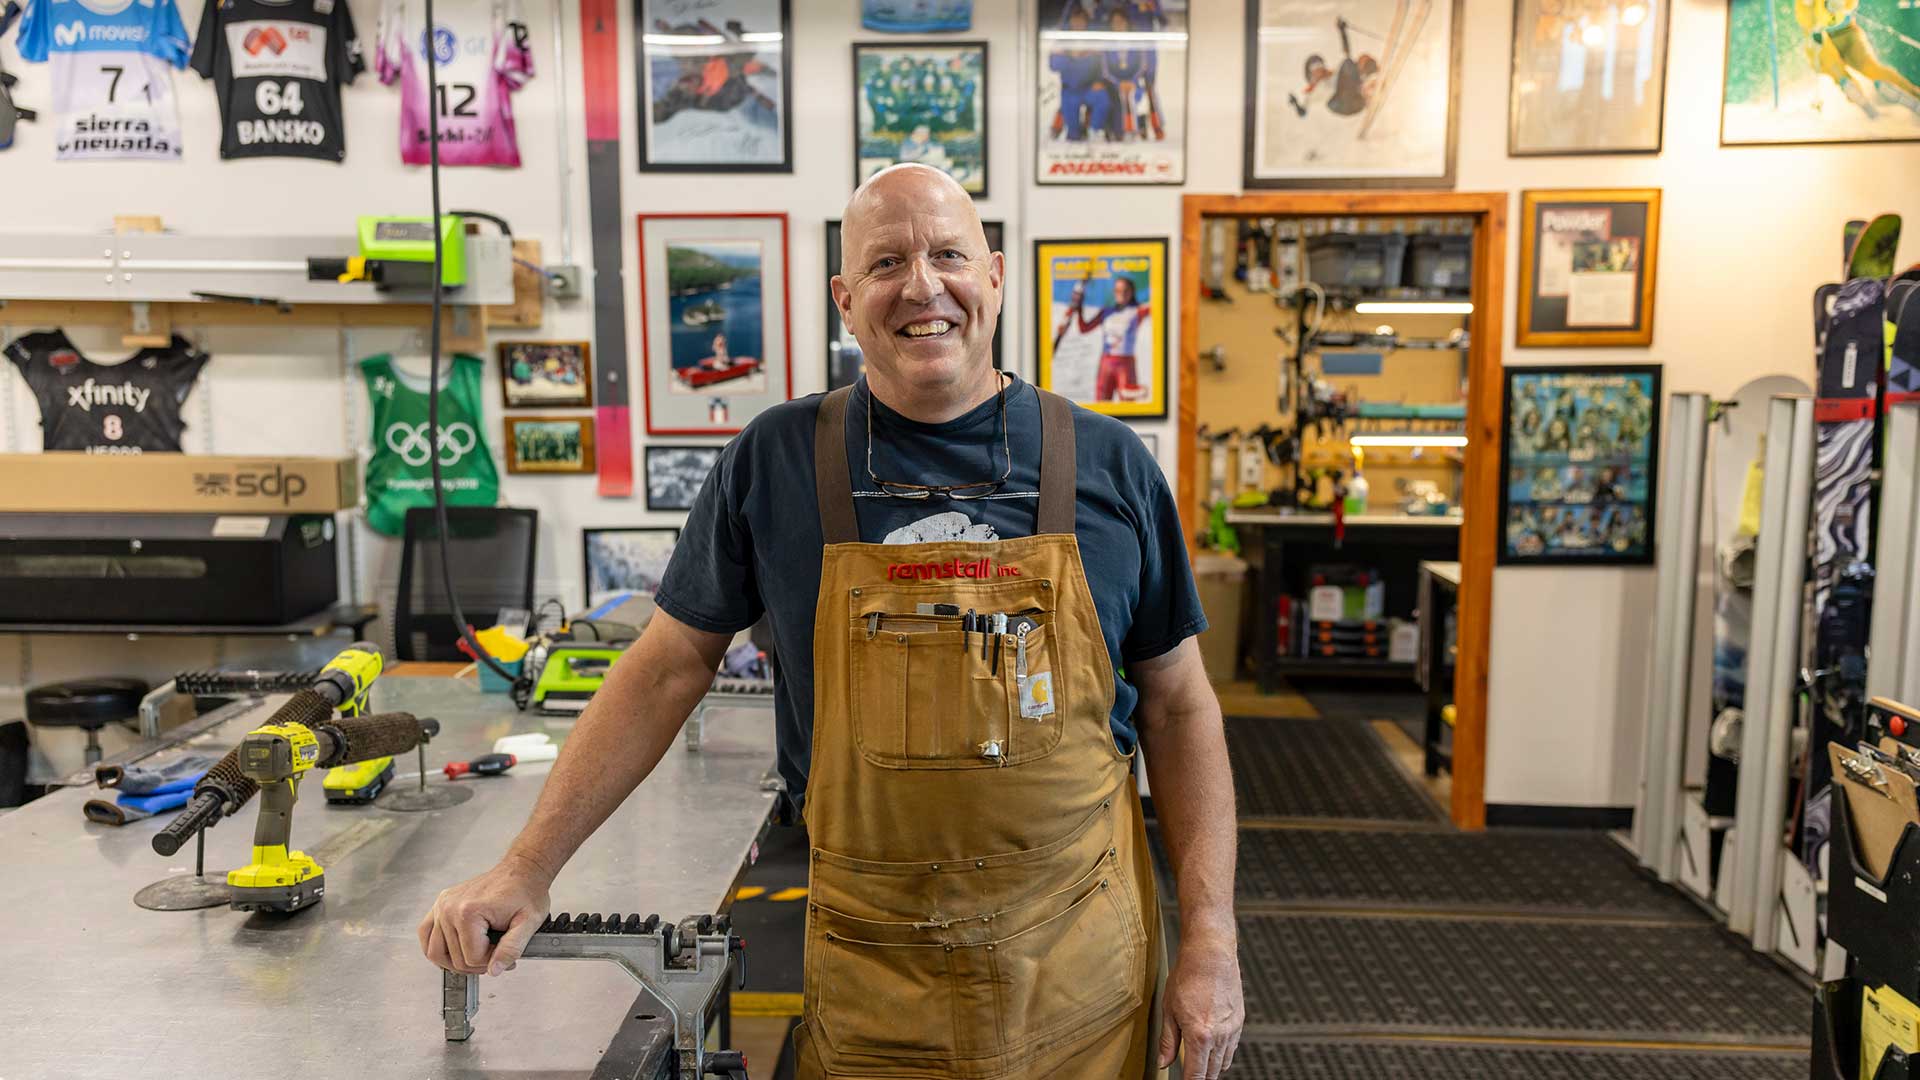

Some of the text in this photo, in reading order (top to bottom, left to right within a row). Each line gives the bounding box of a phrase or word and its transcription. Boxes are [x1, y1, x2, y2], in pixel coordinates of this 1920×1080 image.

[101, 67, 124, 103] 7
[255, 80, 304, 115] 64
[437, 84, 478, 117] 12
[76, 114, 149, 132] sierra
[236, 119, 325, 145] BANSKO
[1541, 210, 1606, 232] Powder
[68, 378, 151, 413] xfinity
[103, 414, 124, 441] 8
[235, 463, 307, 507] sdp
[887, 557, 993, 582] rennstall
